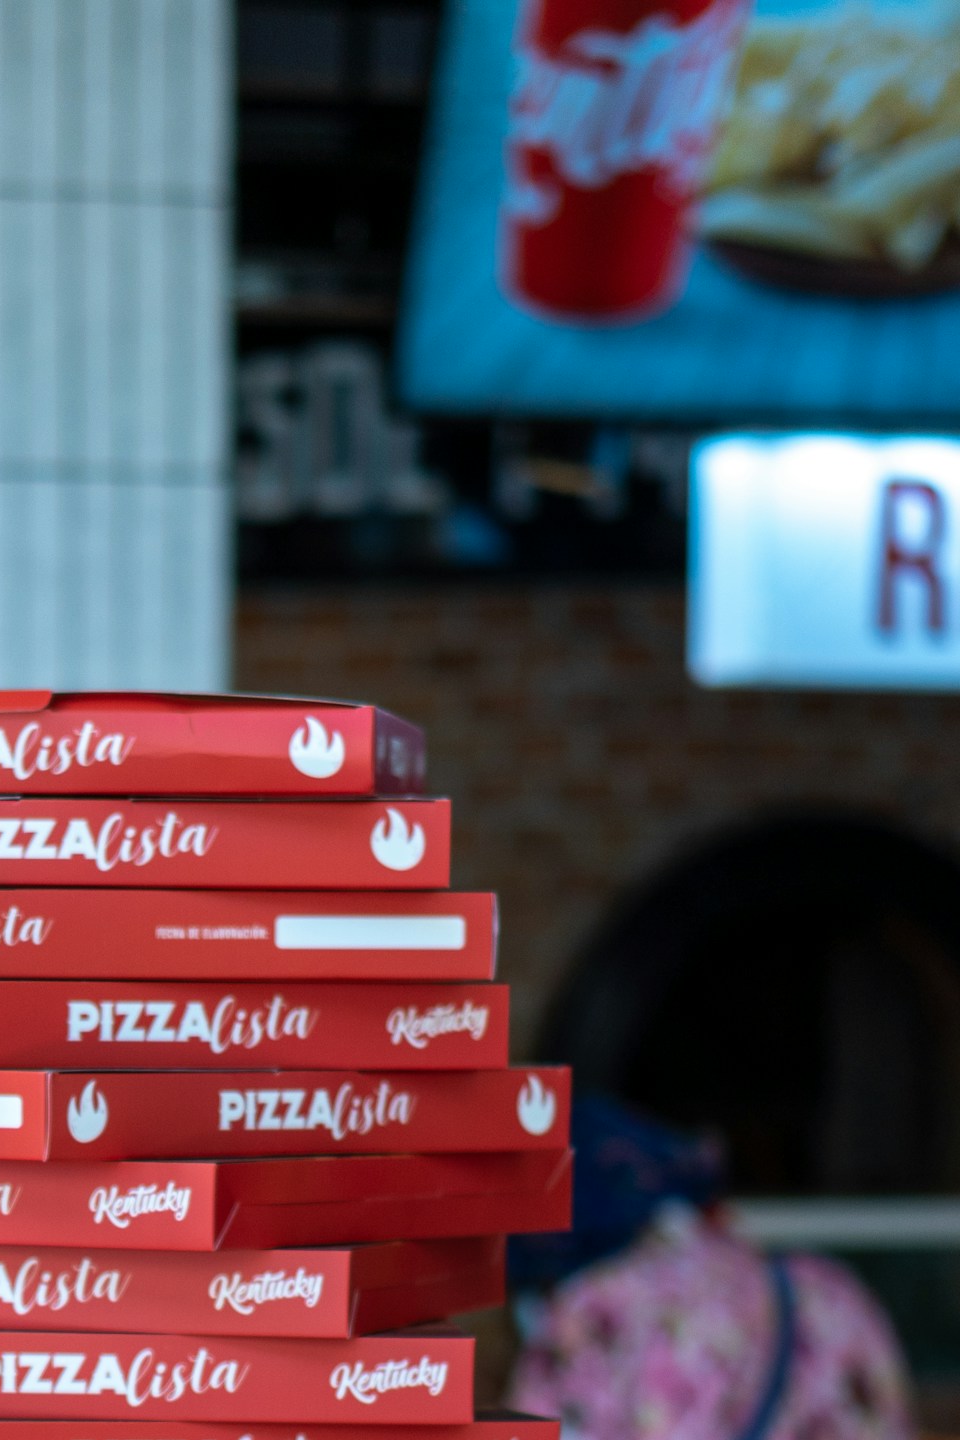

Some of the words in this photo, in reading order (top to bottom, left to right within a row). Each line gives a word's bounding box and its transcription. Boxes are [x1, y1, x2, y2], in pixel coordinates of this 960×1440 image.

[386, 1002, 488, 1049] Kentucky
[89, 1182, 192, 1229] Kentucky
[208, 1268, 325, 1316] Kentucky
[330, 1355, 448, 1404] Kentucky
